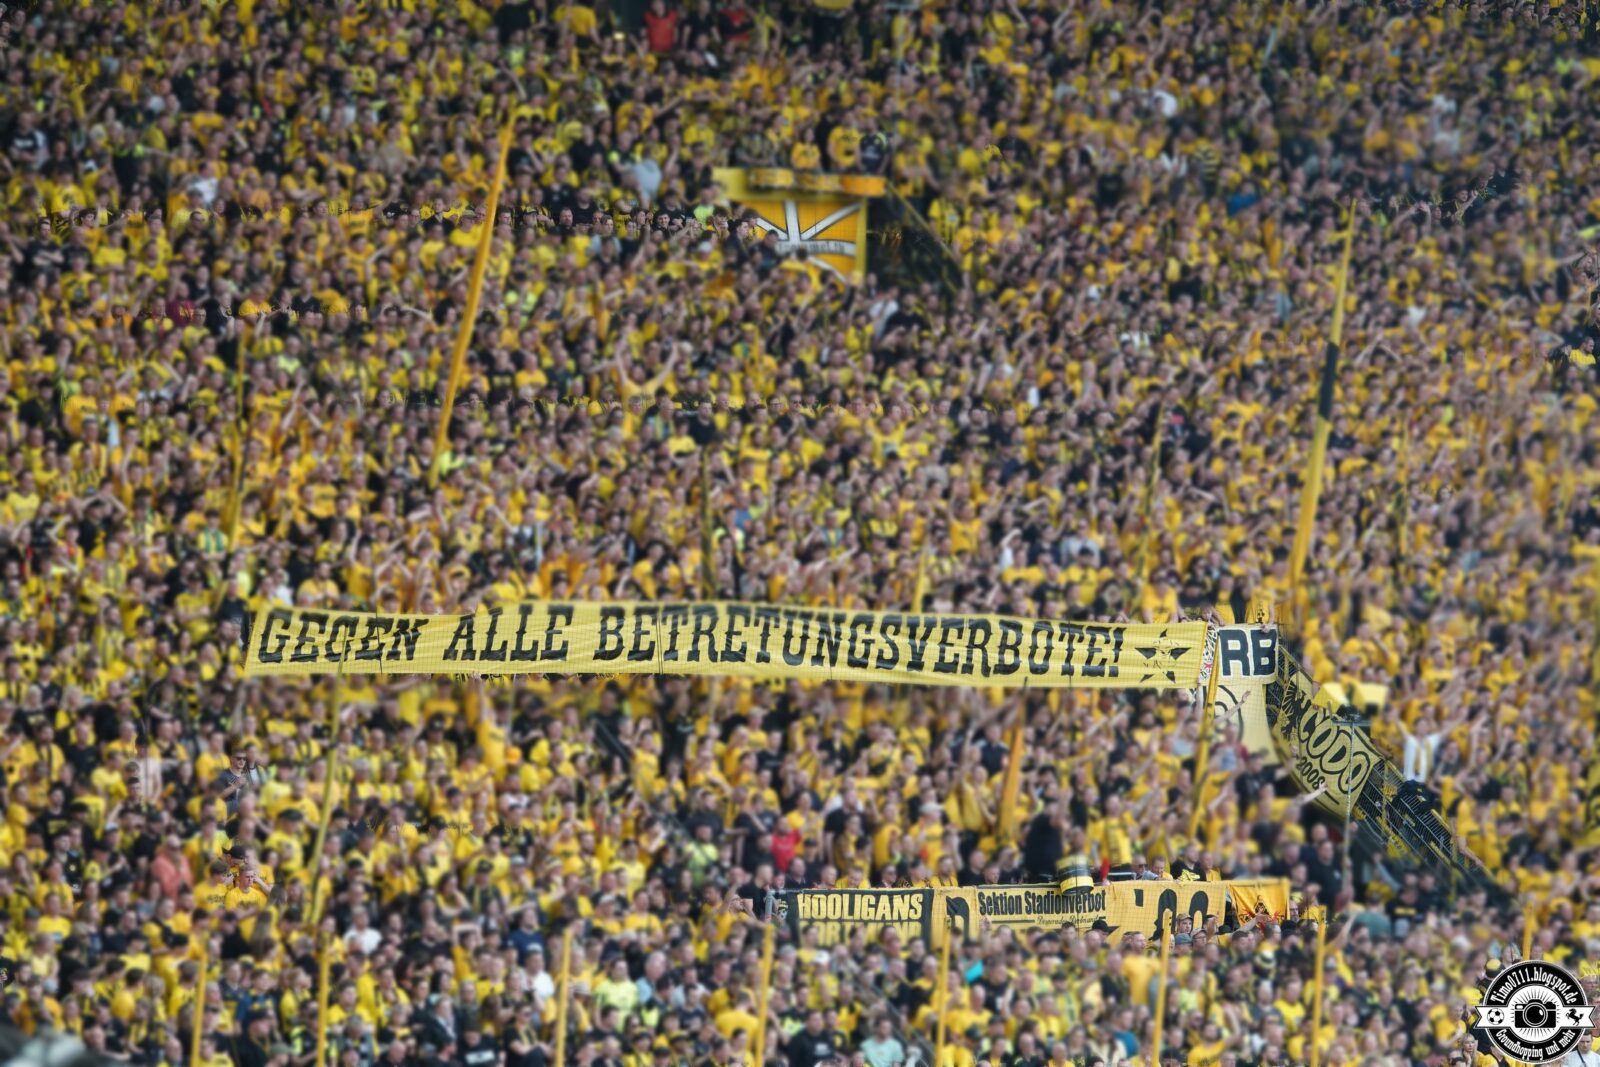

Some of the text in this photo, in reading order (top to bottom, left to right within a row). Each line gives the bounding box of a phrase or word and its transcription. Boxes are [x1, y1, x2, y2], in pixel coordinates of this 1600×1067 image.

[258, 602, 1127, 679] GEGEN ALLE BETRETUNGSVERBOTE!
[796, 893, 924, 921] HOOLIGANS
[977, 889, 1107, 916] Sektion Stadionverbot
